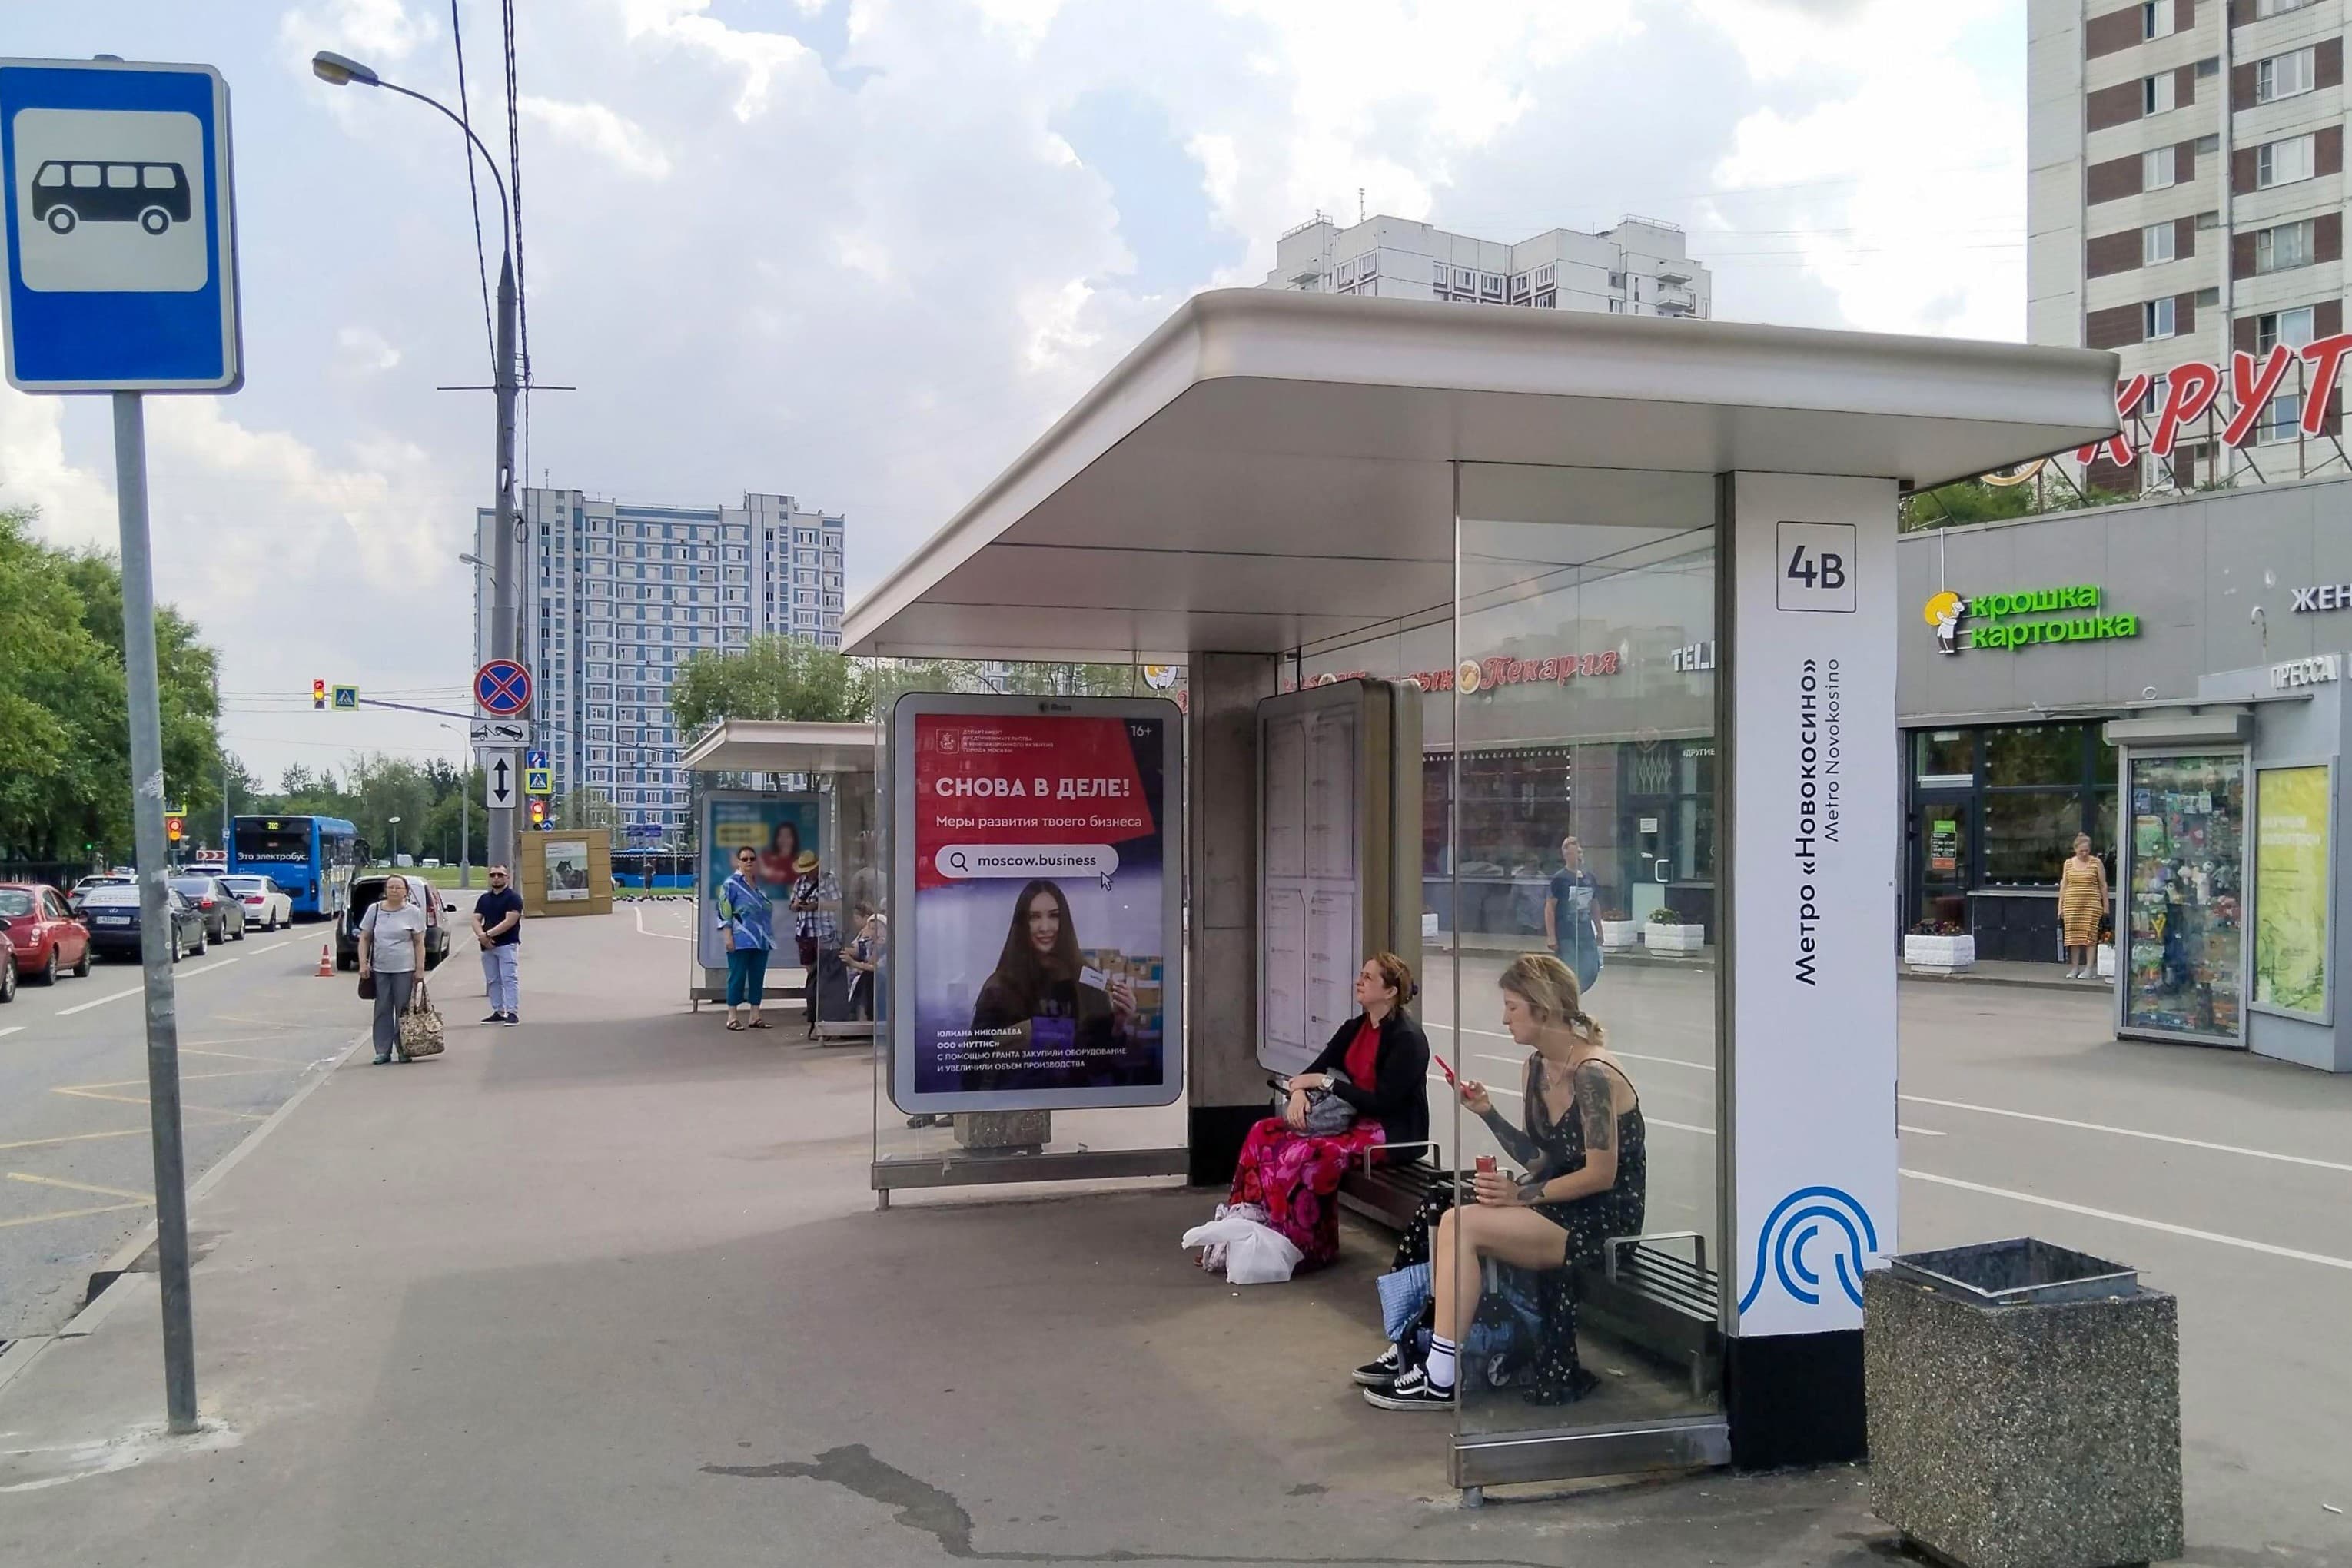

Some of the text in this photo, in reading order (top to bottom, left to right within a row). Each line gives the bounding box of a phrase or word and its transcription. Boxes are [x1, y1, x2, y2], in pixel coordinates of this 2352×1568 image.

[1970, 583, 2101, 622] крошка
[1970, 613, 2138, 653] картошка
[2271, 655, 2337, 690] ПРЕССА
[1131, 725, 1152, 736] 16+
[1825, 658, 1839, 843] Metro Novokosino
[935, 777, 1130, 800] СНОВА В ДЕЛЕ!
[936, 815, 1142, 829] Меры развития твоего бизнеса
[1794, 657, 1820, 987] Метро «Новокосино»
[238, 852, 309, 862] Это электробус.
[978, 853, 1097, 867] moscow.business
[958, 1040, 1000, 1048] «НУТТИС»
[1065, 1047, 1127, 1056] ОБОРУДОВАНИЕ
[945, 1064, 993, 1072] УВЕЛИЧИЛИ
[1023, 1061, 1086, 1069] ПРОИЗВОДСТВА
